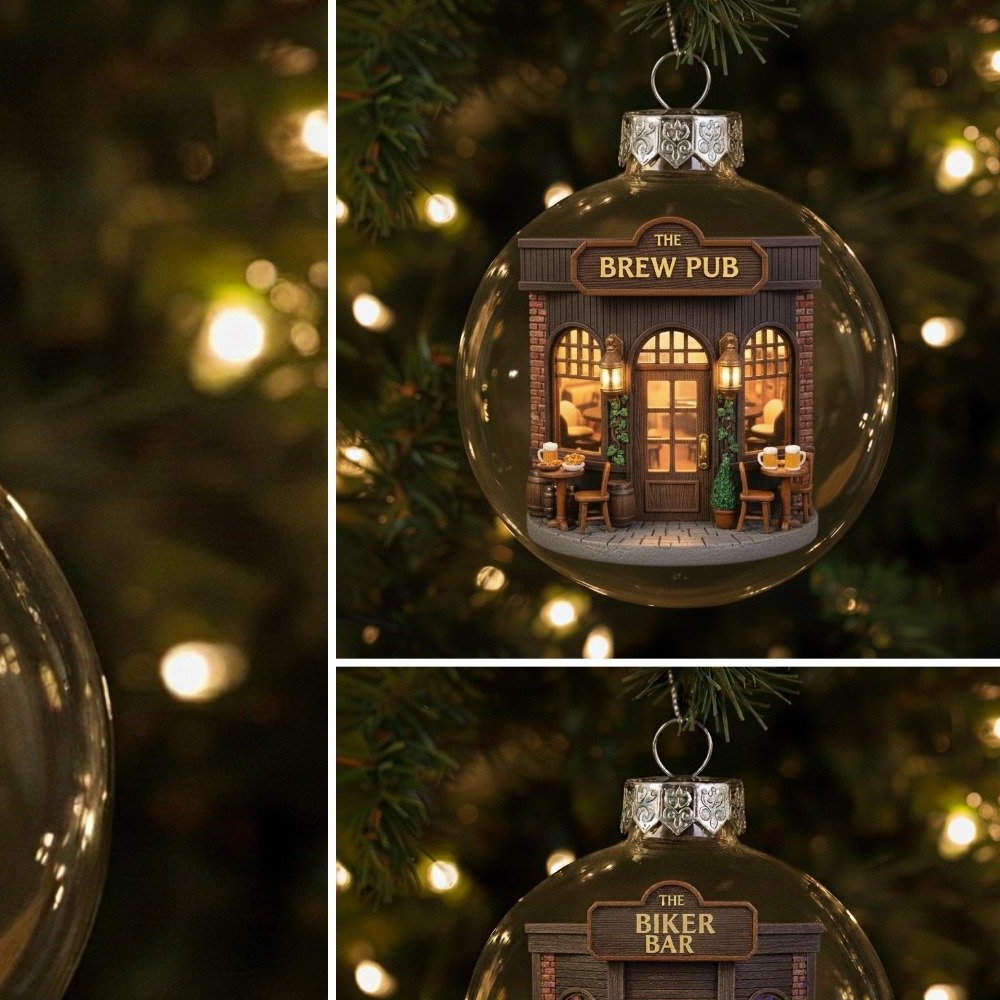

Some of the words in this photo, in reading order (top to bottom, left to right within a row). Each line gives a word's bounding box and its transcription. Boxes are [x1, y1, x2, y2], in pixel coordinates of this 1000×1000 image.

[654, 234, 681, 246] THE
[600, 257, 676, 278] BREW
[686, 257, 739, 278] PUB
[659, 895, 685, 907] THE
[635, 913, 715, 934] BIKER
[645, 935, 694, 954] BAR
